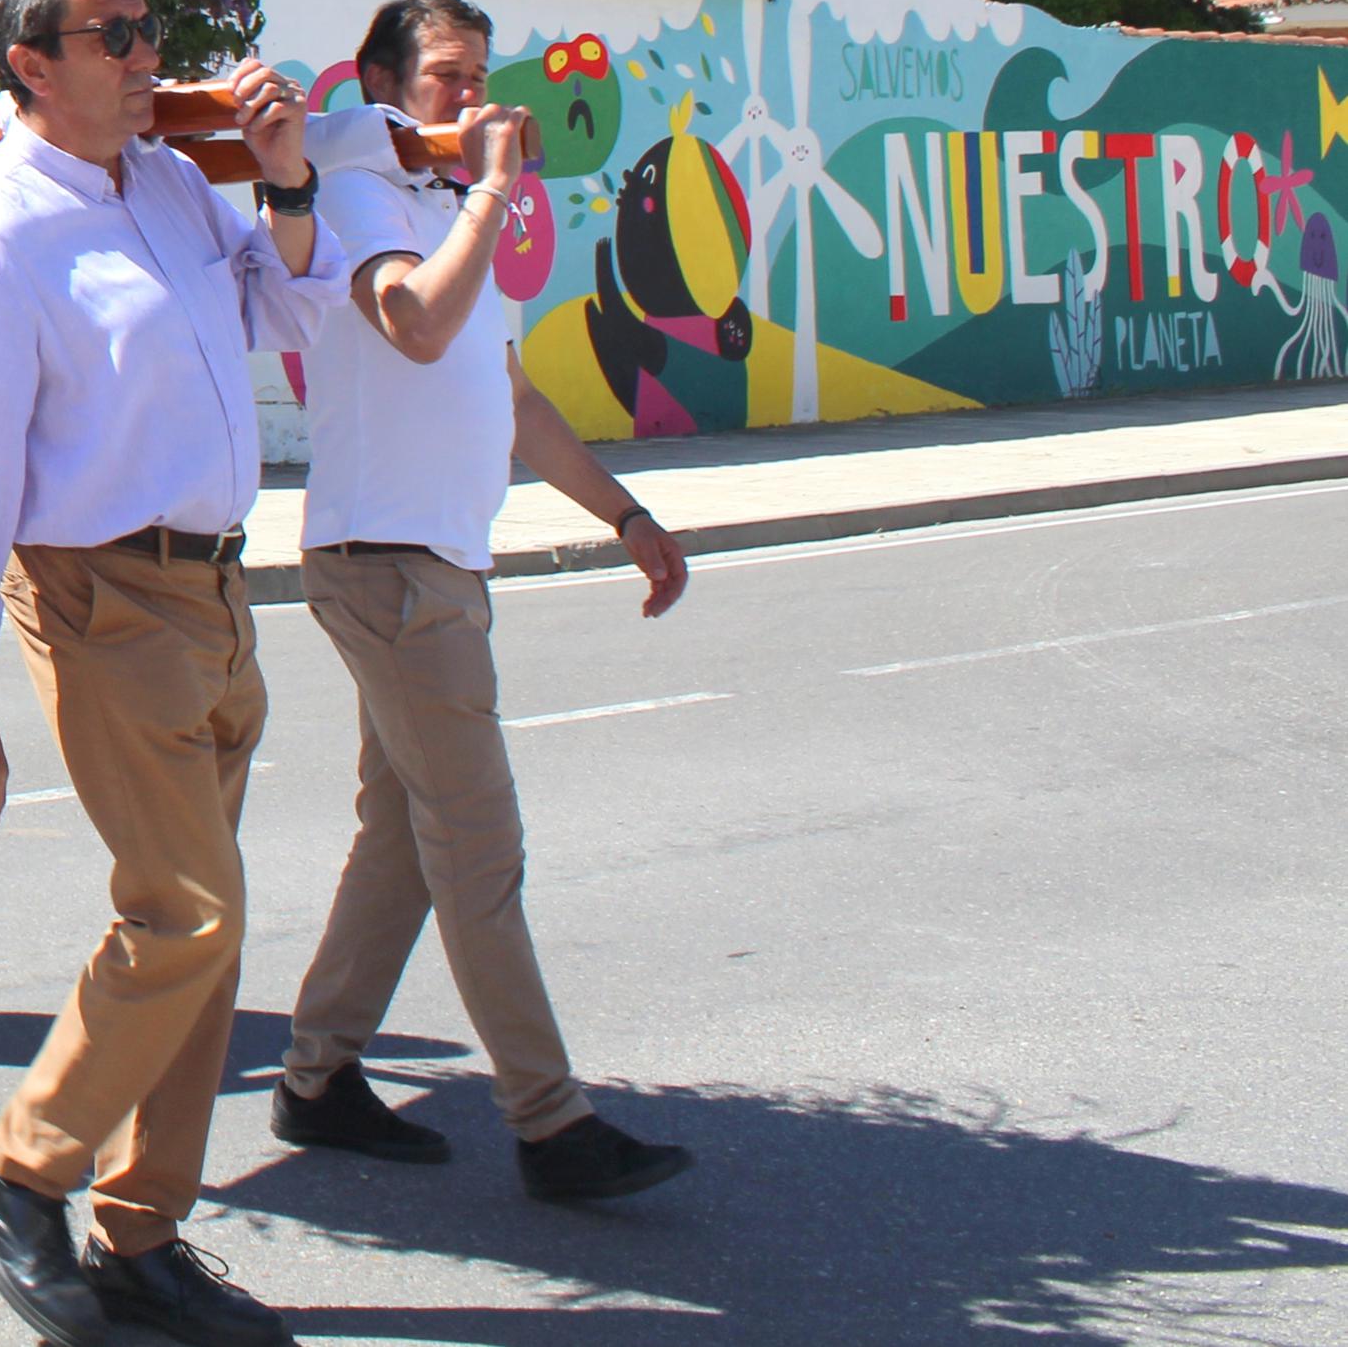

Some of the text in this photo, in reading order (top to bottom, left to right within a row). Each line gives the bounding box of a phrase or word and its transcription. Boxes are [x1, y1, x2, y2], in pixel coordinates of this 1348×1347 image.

[839, 42, 964, 101] SALVEMOS
[884, 129, 1271, 321] NUESTRO
[1114, 310, 1223, 372] PLANETA
